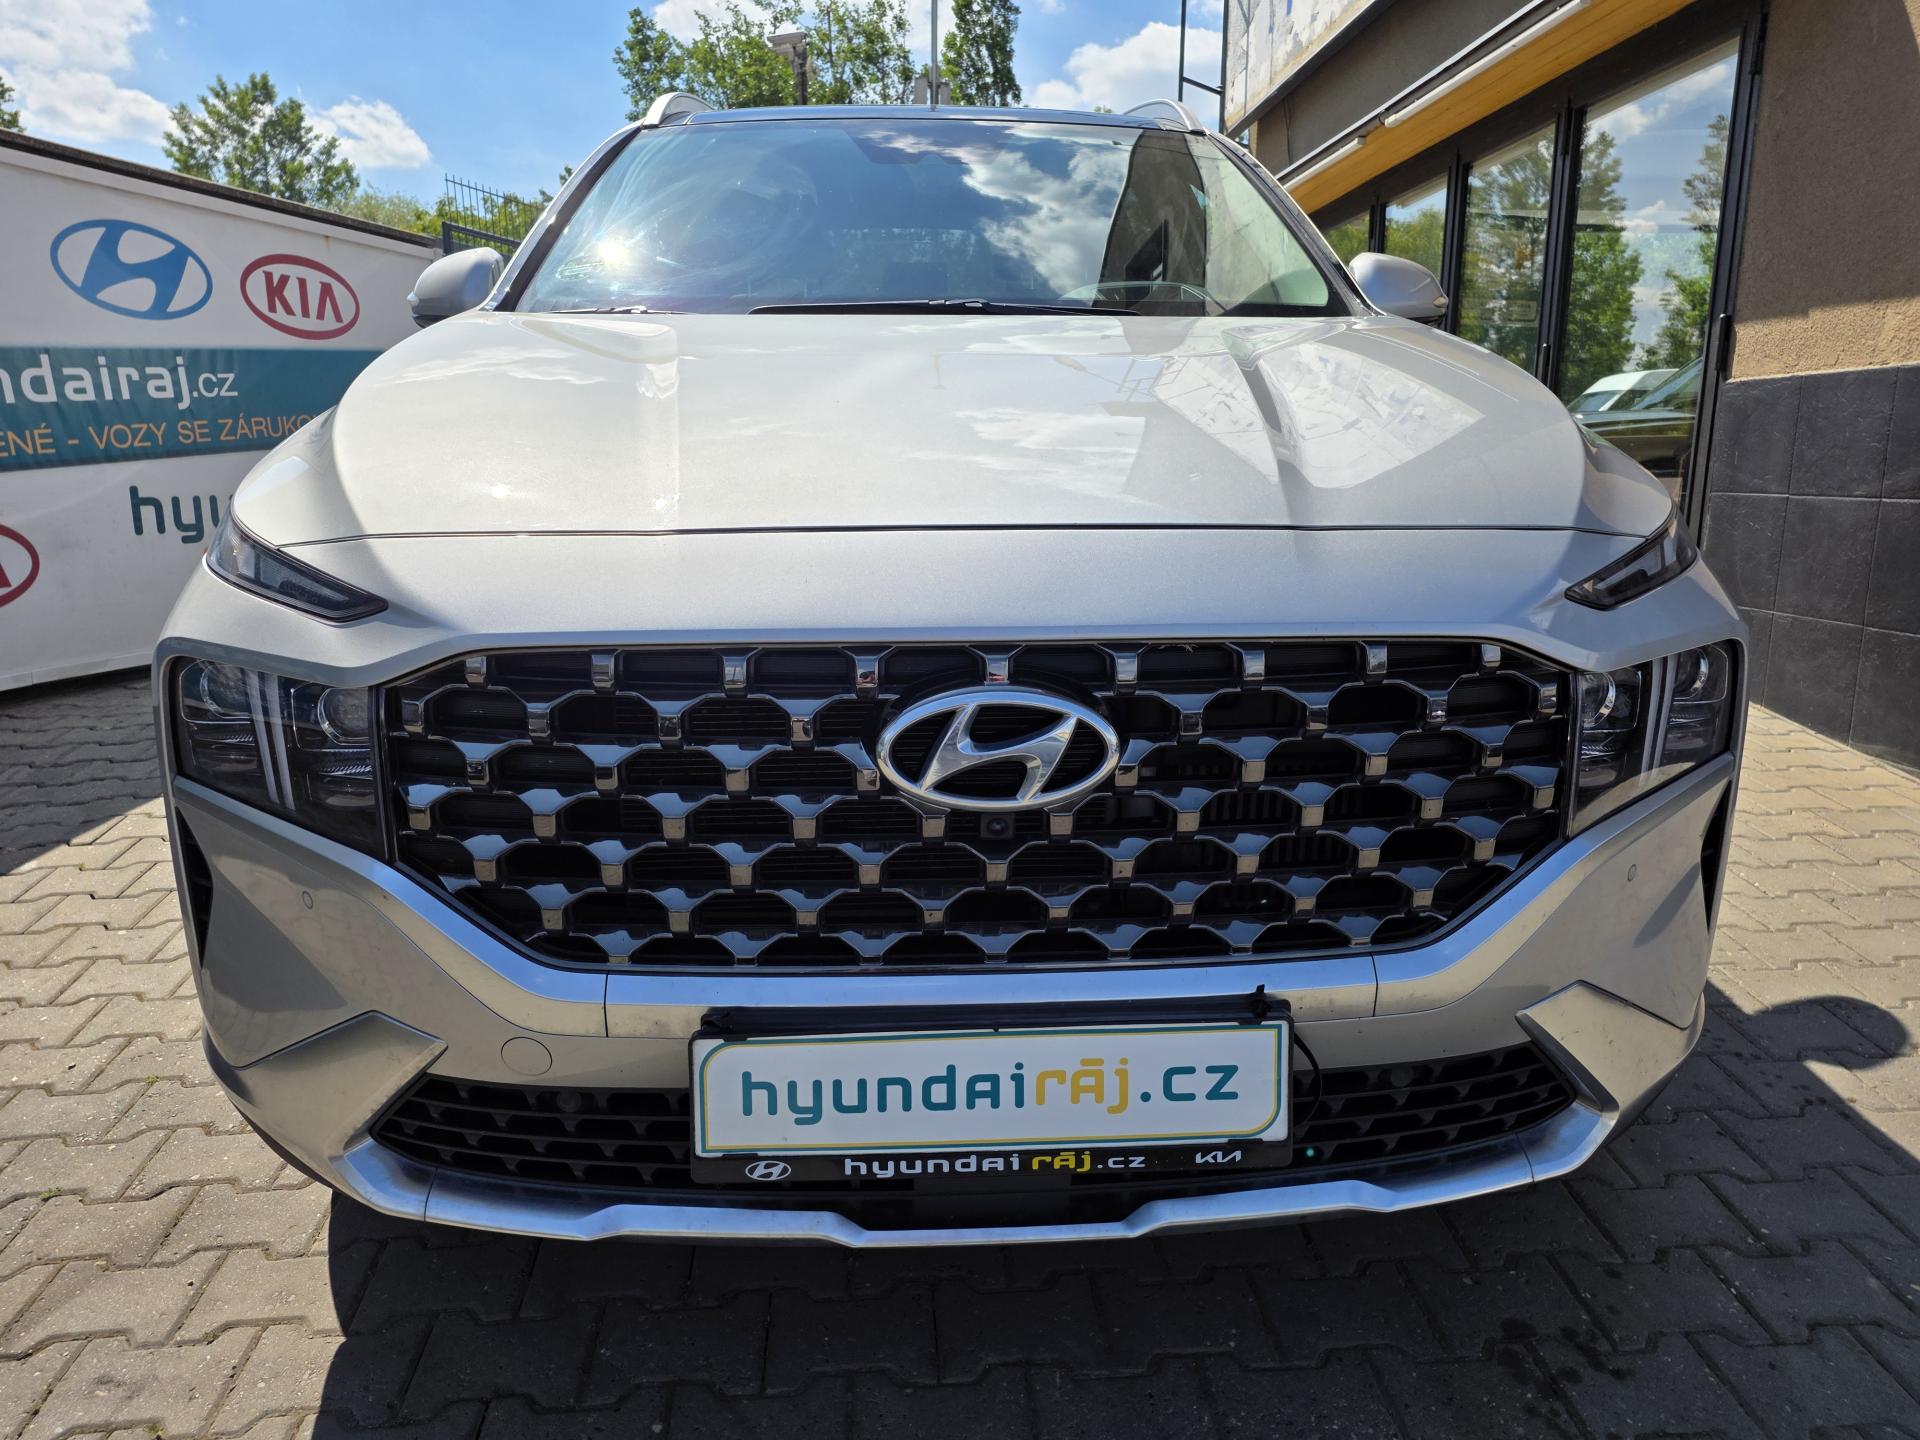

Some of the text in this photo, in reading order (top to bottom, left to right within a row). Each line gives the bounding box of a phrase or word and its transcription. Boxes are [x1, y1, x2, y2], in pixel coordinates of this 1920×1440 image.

[262, 270, 344, 324] KIA
[88, 421, 167, 450] VOZY
[176, 418, 212, 444] SE
[218, 412, 318, 441] ZÁRUKO
